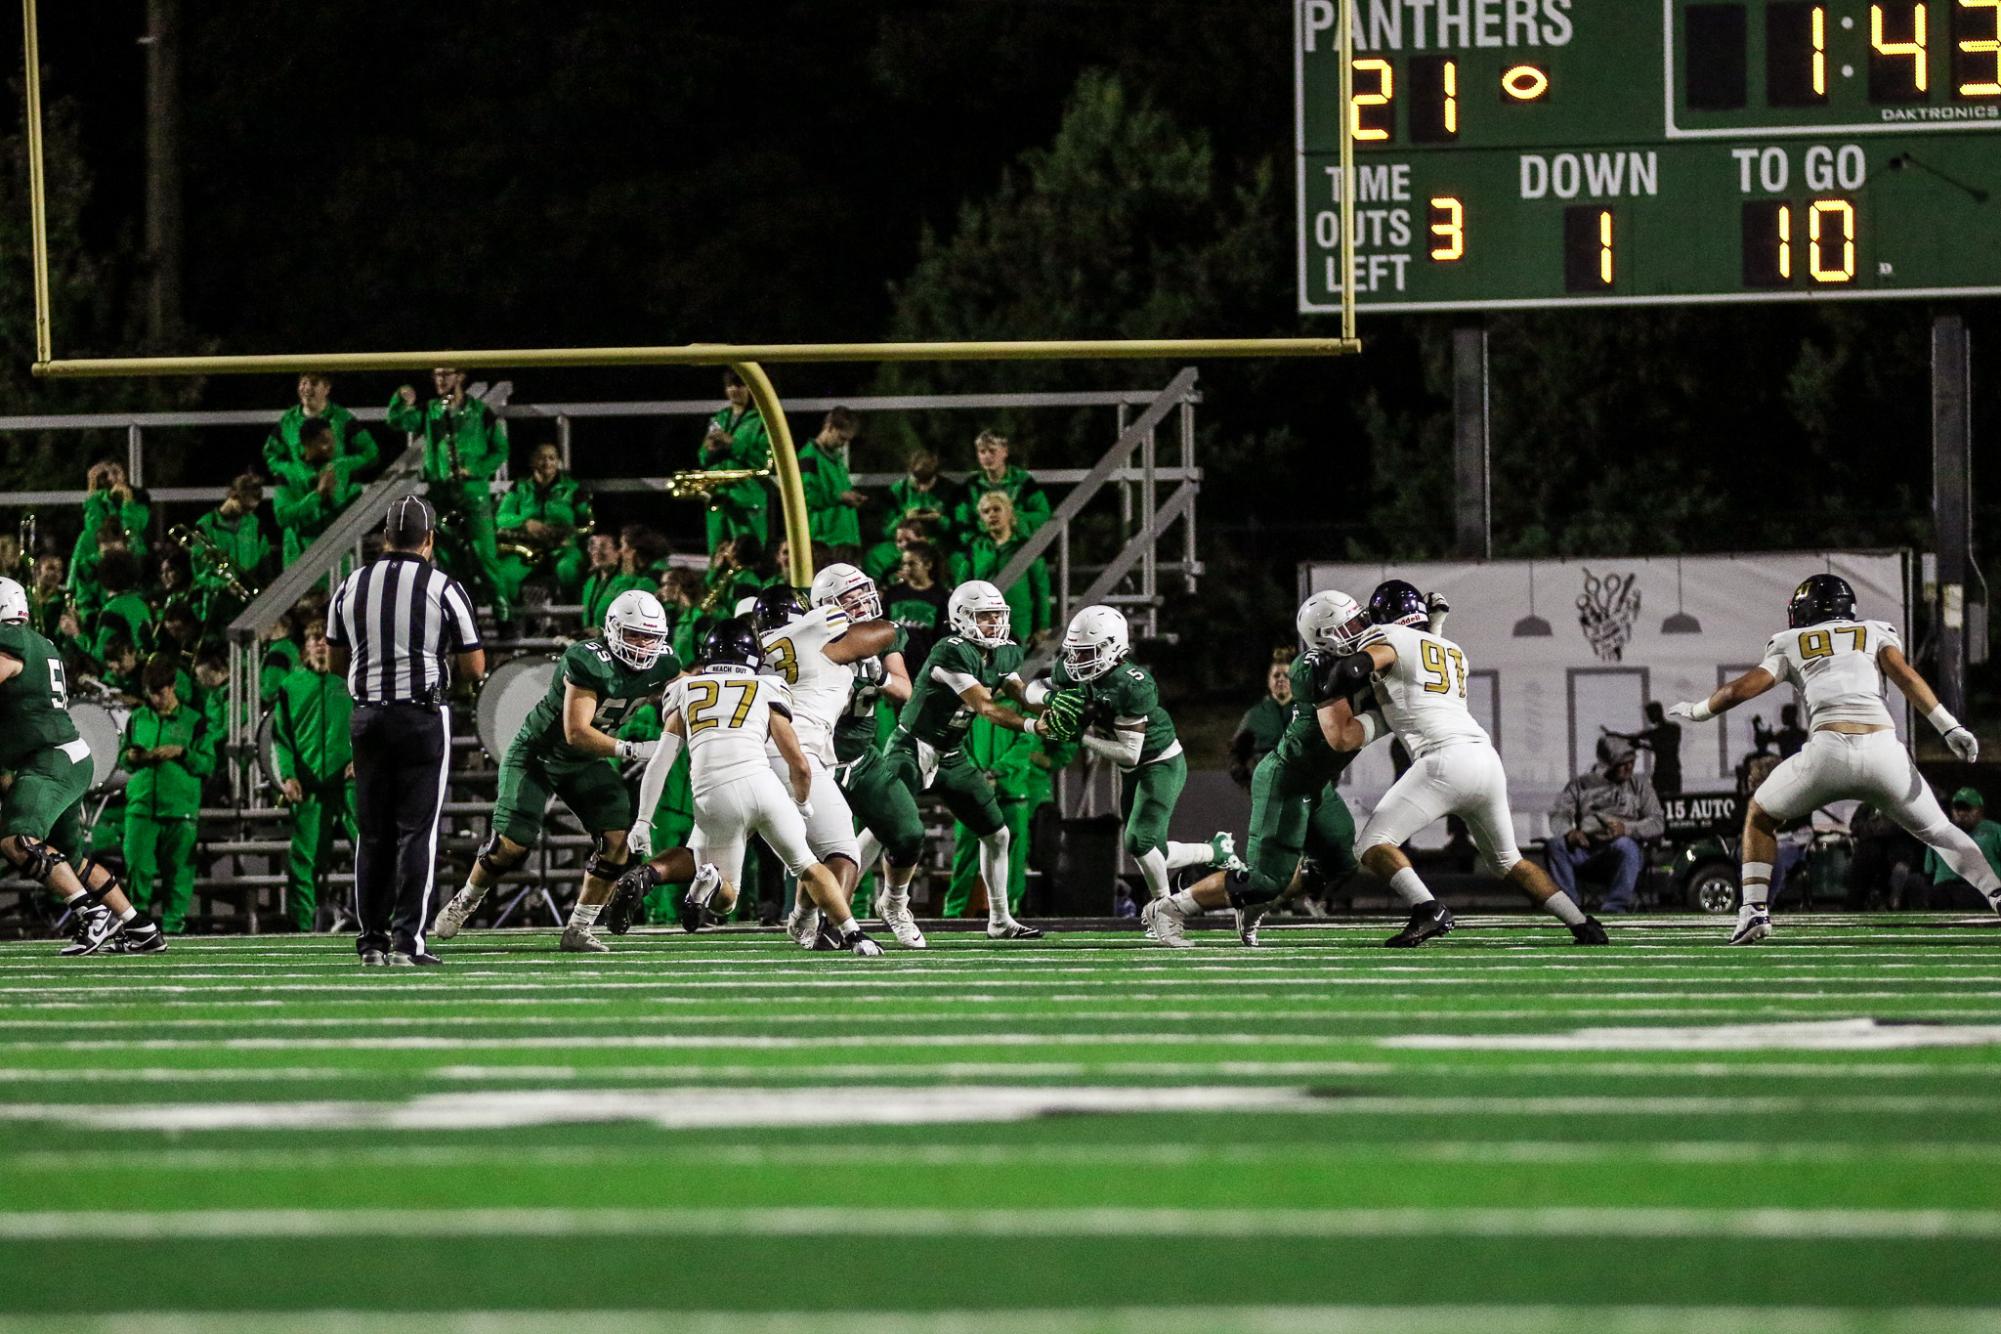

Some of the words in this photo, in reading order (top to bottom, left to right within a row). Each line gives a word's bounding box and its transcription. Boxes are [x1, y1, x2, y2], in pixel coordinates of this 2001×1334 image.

[1304, 0, 1574, 52] PANTHERS
[1881, 104, 2000, 122] DAKTRONICS
[1519, 151, 1658, 200] DOWN
[1731, 147, 1789, 193] TO
[1804, 144, 1866, 191] GO
[1430, 197, 1464, 260] 3
[1778, 199, 1855, 283] 10
[1326, 253, 1412, 293] LEFT
[585, 640, 612, 663] 59
[1798, 625, 1867, 660] 97
[1126, 667, 1145, 681] 5
[1420, 638, 1466, 698] 91
[686, 680, 759, 736] 27
[1665, 800, 1686, 820] 15
